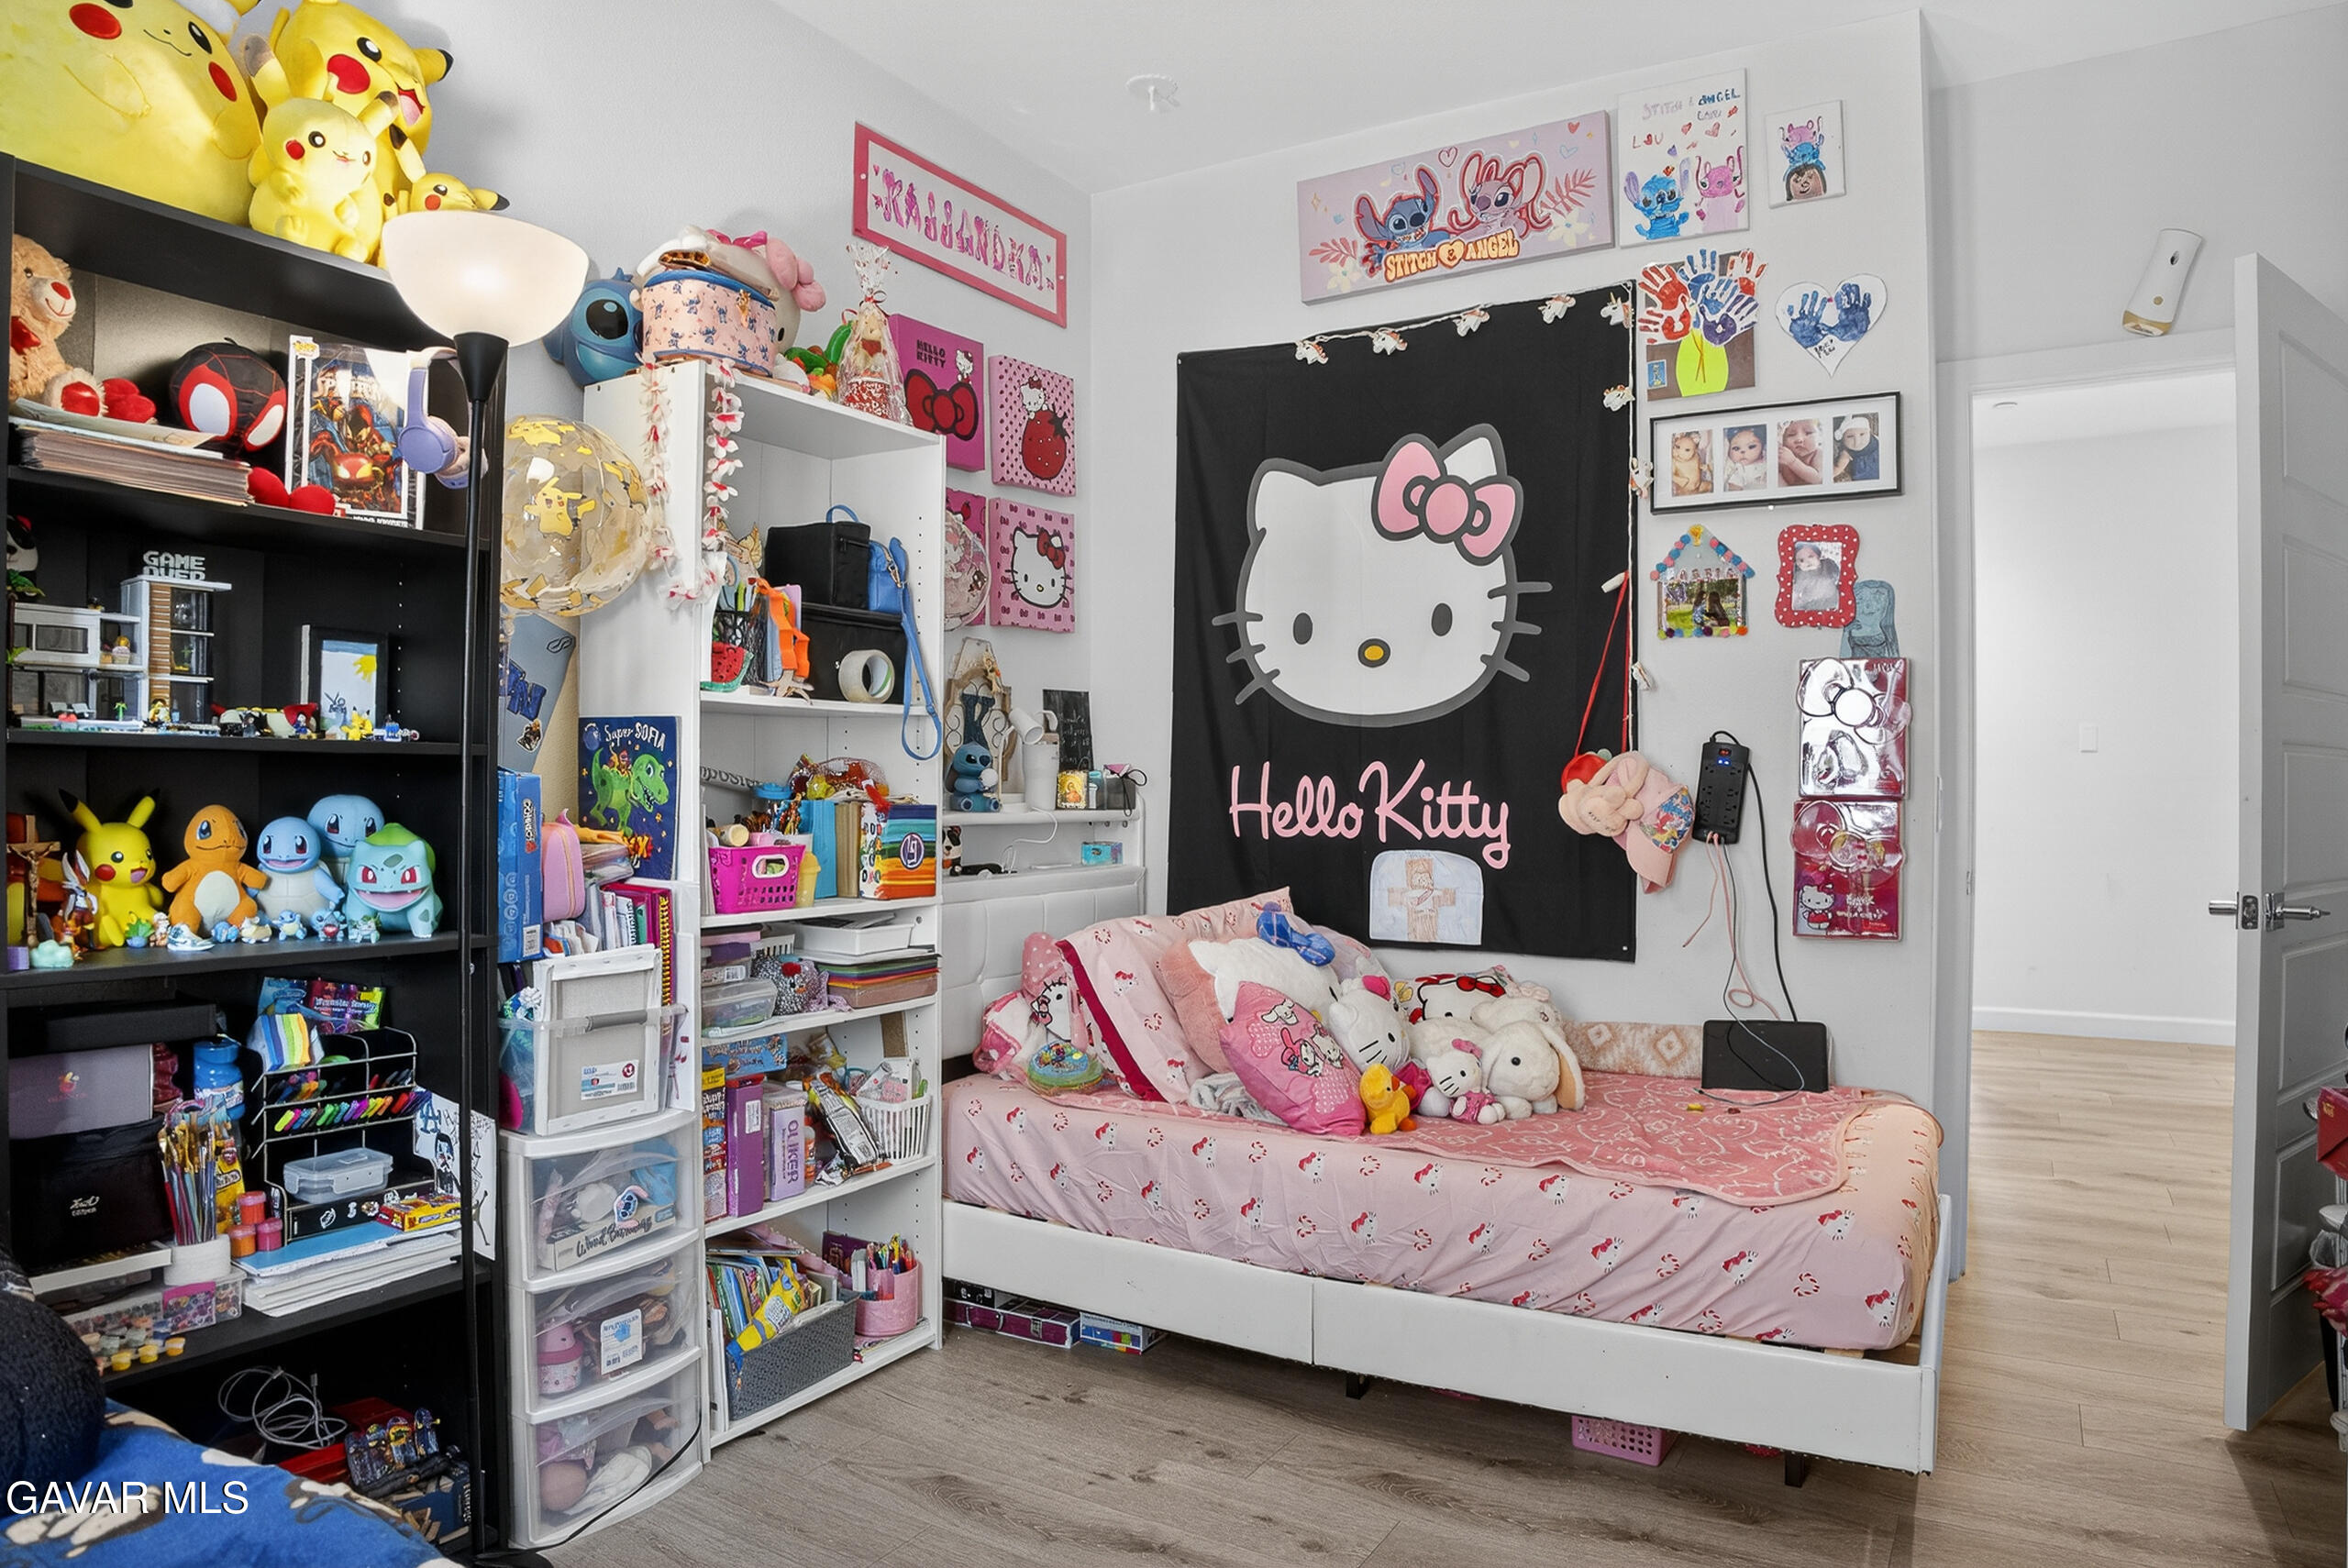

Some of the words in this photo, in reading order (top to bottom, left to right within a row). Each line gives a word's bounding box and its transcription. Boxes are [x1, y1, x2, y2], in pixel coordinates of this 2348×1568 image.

[1385, 250, 1438, 282] STITCH
[1465, 228, 1520, 261] ANGEL
[917, 339, 946, 358] HELLO
[917, 351, 946, 369] KITTY
[143, 550, 205, 570] GAME
[604, 724, 633, 746] Super
[635, 722, 666, 752] SOFIA
[1230, 759, 1364, 840] Hello
[1358, 758, 1512, 870] Kitty
